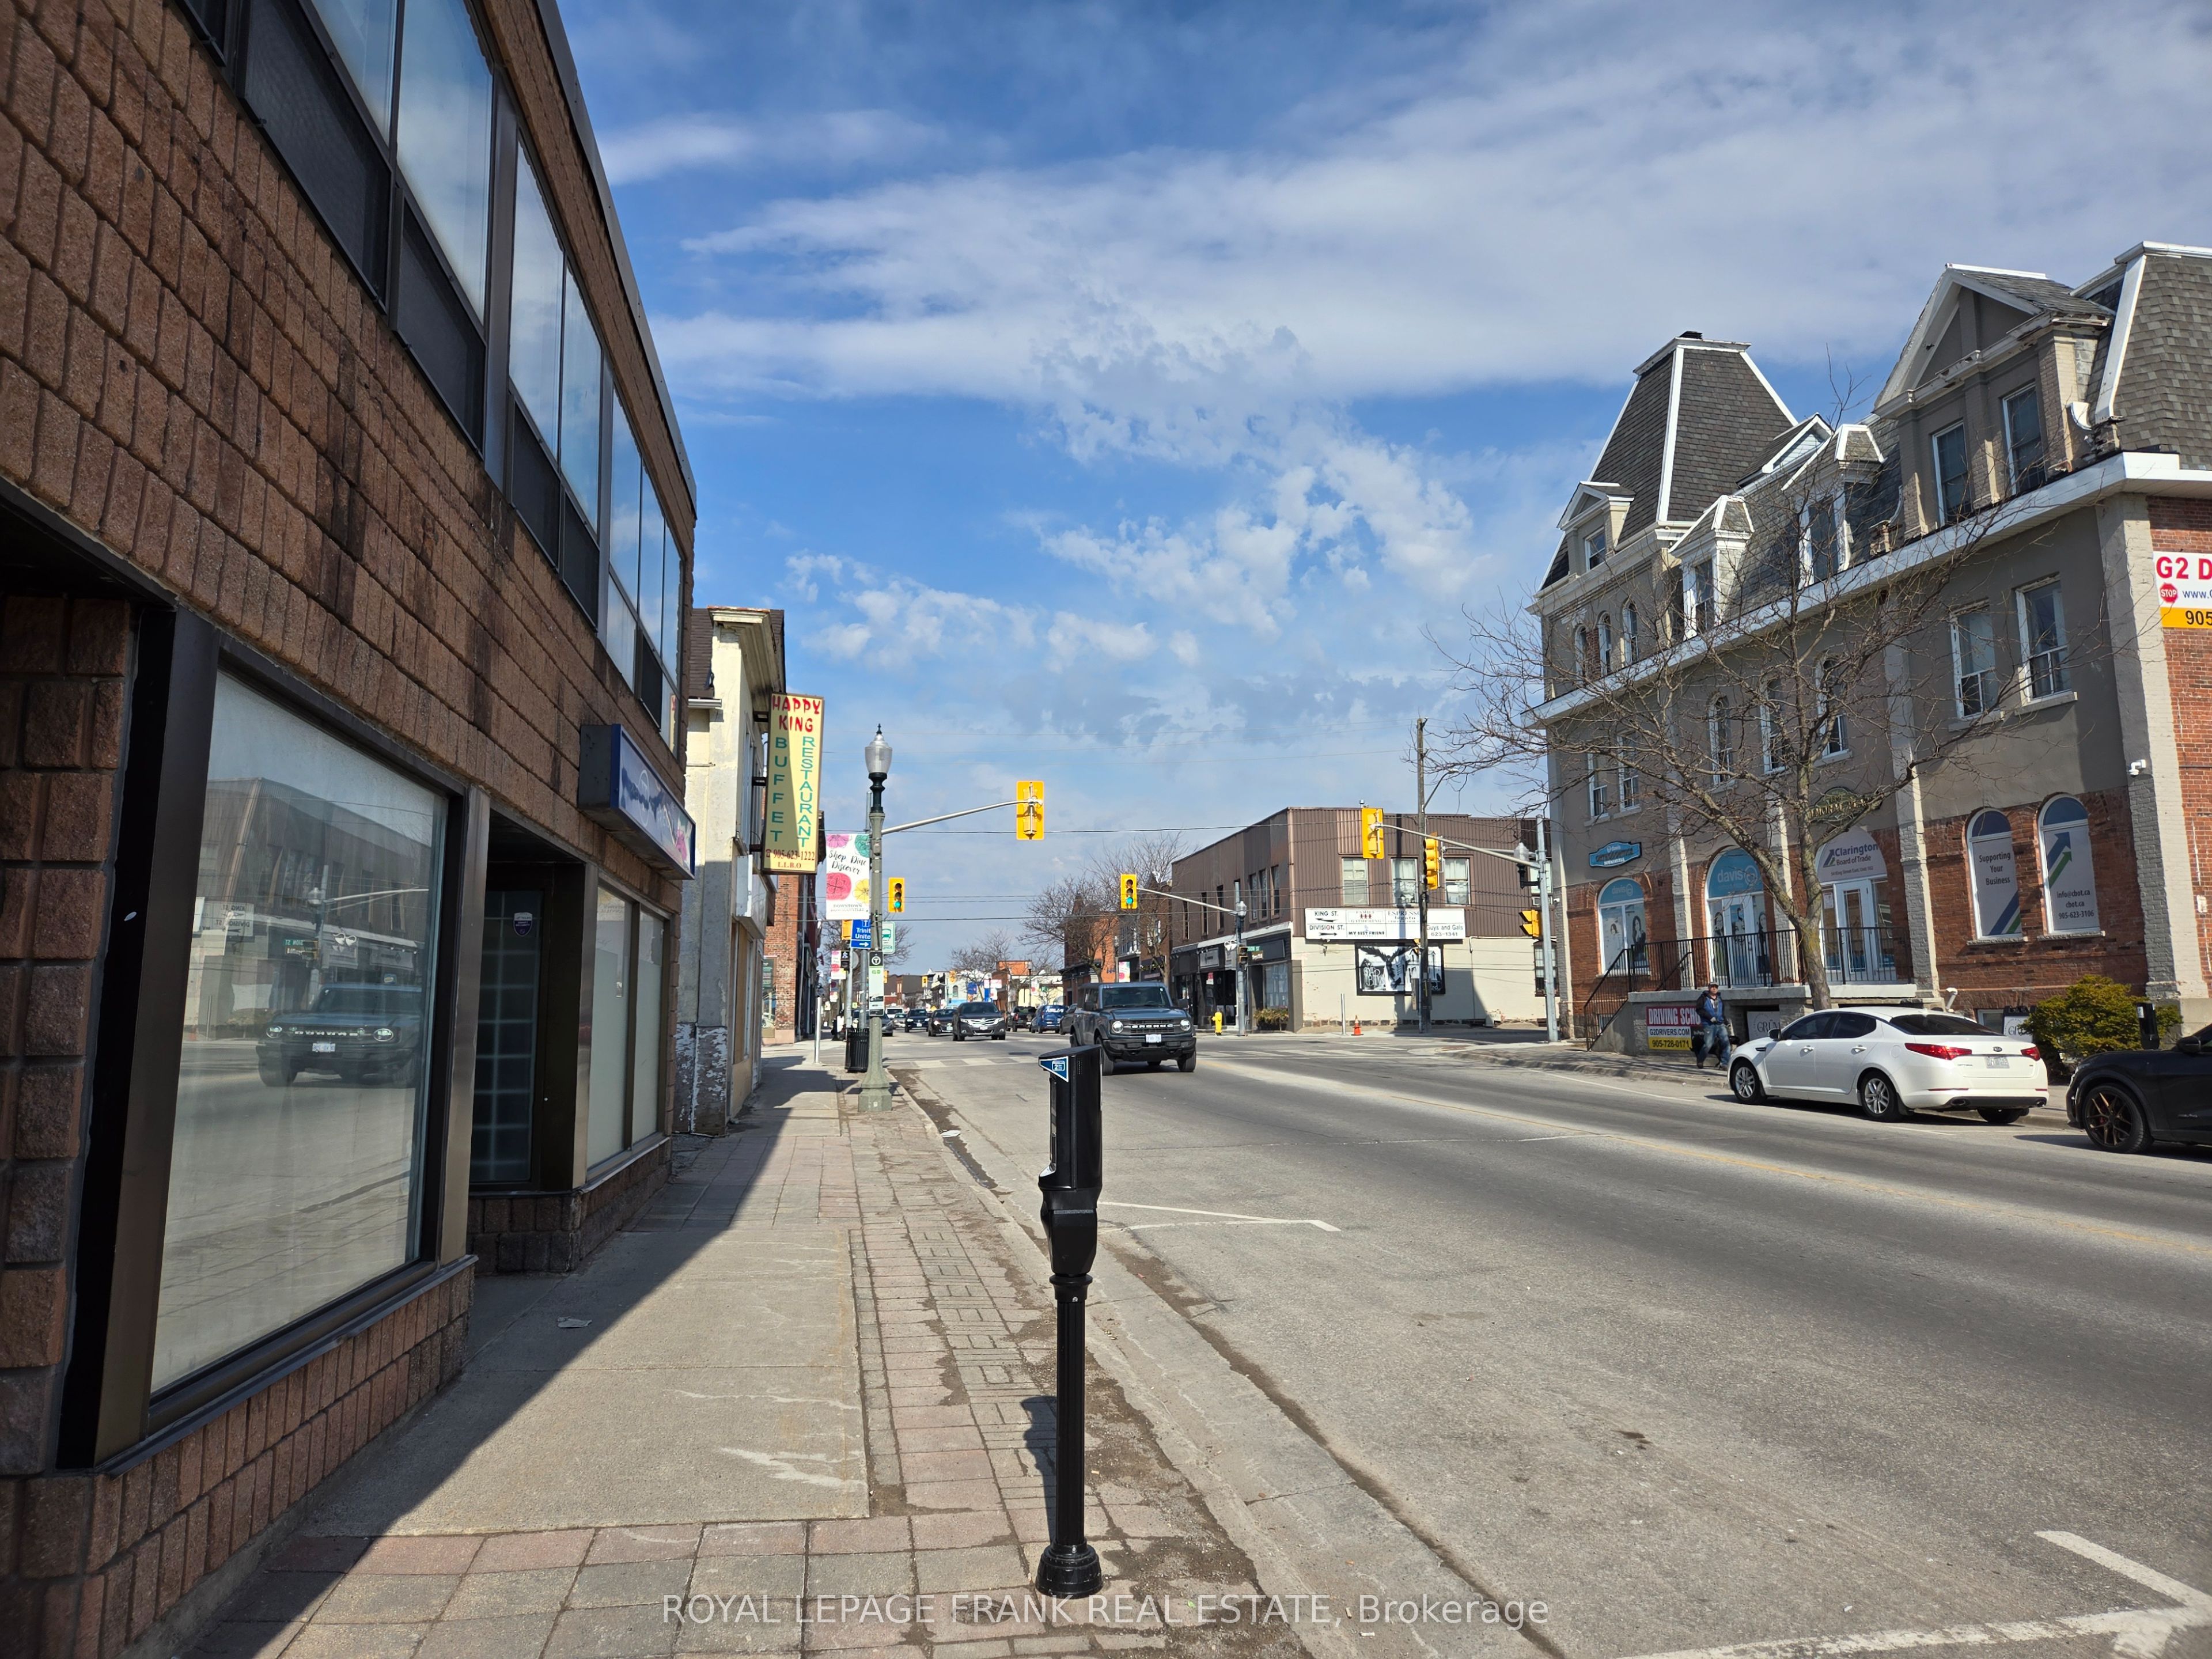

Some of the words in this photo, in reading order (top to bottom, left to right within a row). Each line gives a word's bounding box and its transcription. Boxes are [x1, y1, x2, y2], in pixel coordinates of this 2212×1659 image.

[2156, 556, 2189, 579] G2
[2161, 589, 2177, 598] STOP
[772, 695, 821, 714] HAPPY
[779, 715, 813, 732] KING
[770, 737, 788, 842] BUFFET
[797, 736, 816, 847] RESTAURANT
[773, 849, 815, 861] 905-623-1222
[1835, 843, 1878, 857] Clarington
[1836, 858, 1851, 866] Board
[1979, 852, 2010, 863] Supporting
[831, 861, 860, 874] Discover
[1717, 866, 1743, 882] davis
[1986, 877, 2010, 885] Business
[2056, 890, 2090, 898] info@cbot.ca
[2058, 910, 2094, 919] 905-623-3106
[1648, 1008, 1678, 1025] DRIVING
[1652, 1040, 1690, 1048] 905-728-0171
